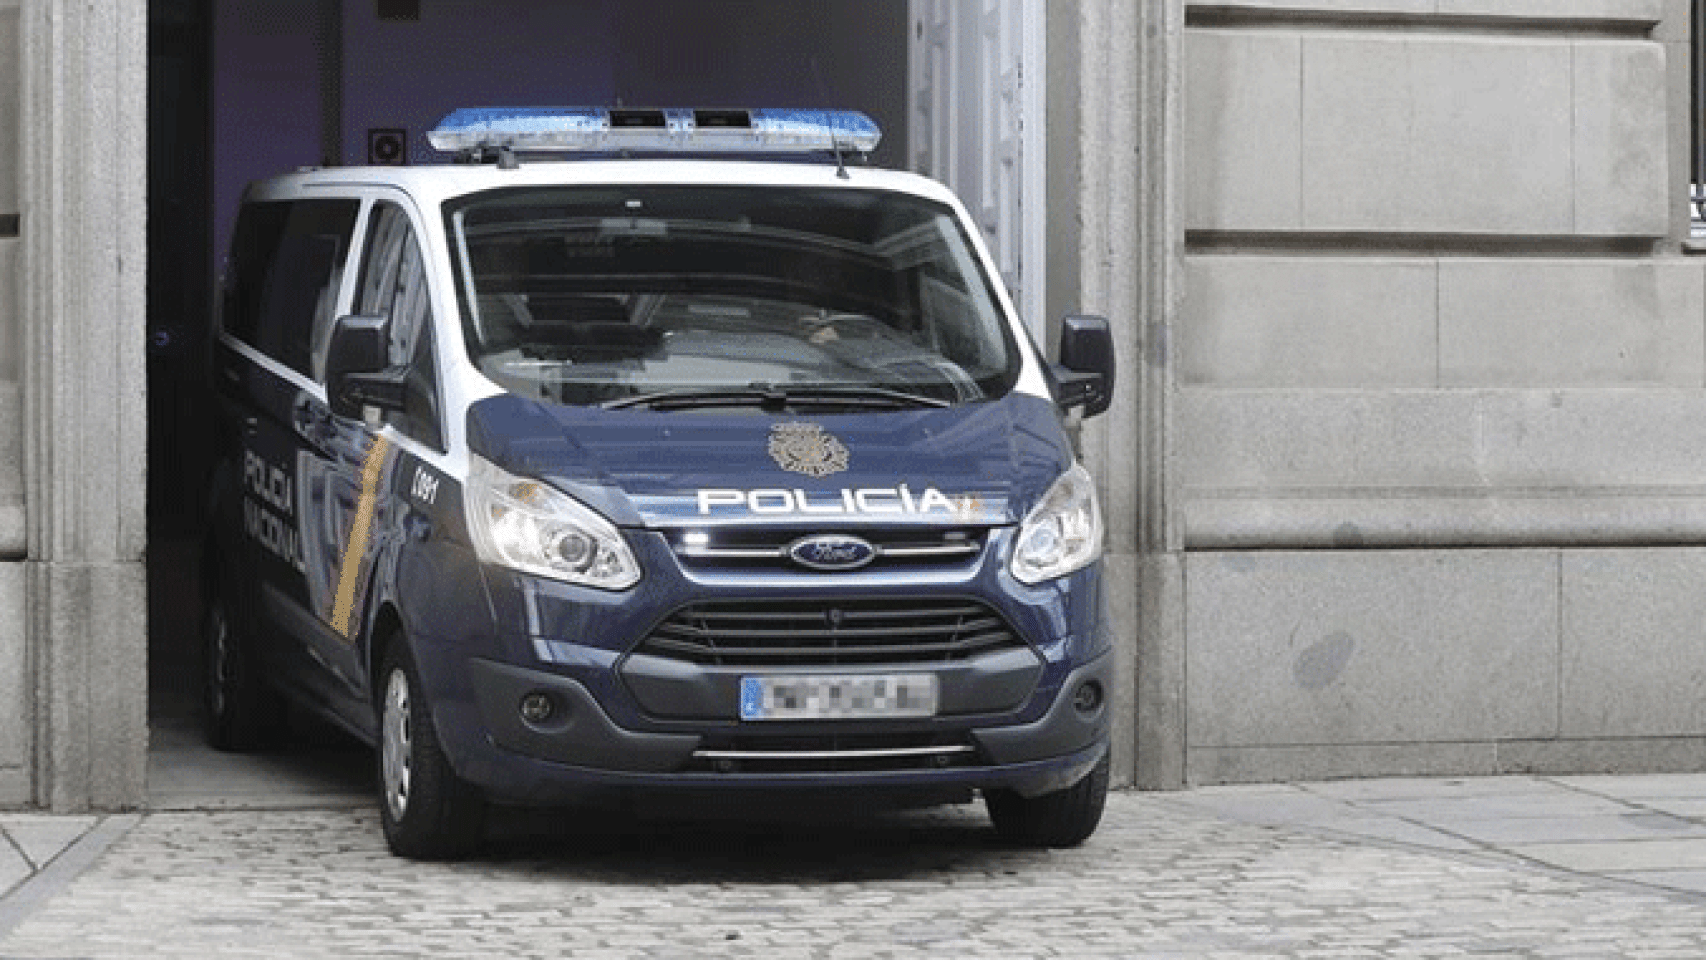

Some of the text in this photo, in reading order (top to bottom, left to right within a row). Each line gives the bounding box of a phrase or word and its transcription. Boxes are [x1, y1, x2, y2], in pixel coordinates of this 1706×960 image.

[411, 465, 439, 504] 091
[697, 483, 959, 515] POLICÍA
[811, 541, 857, 560] Ford
